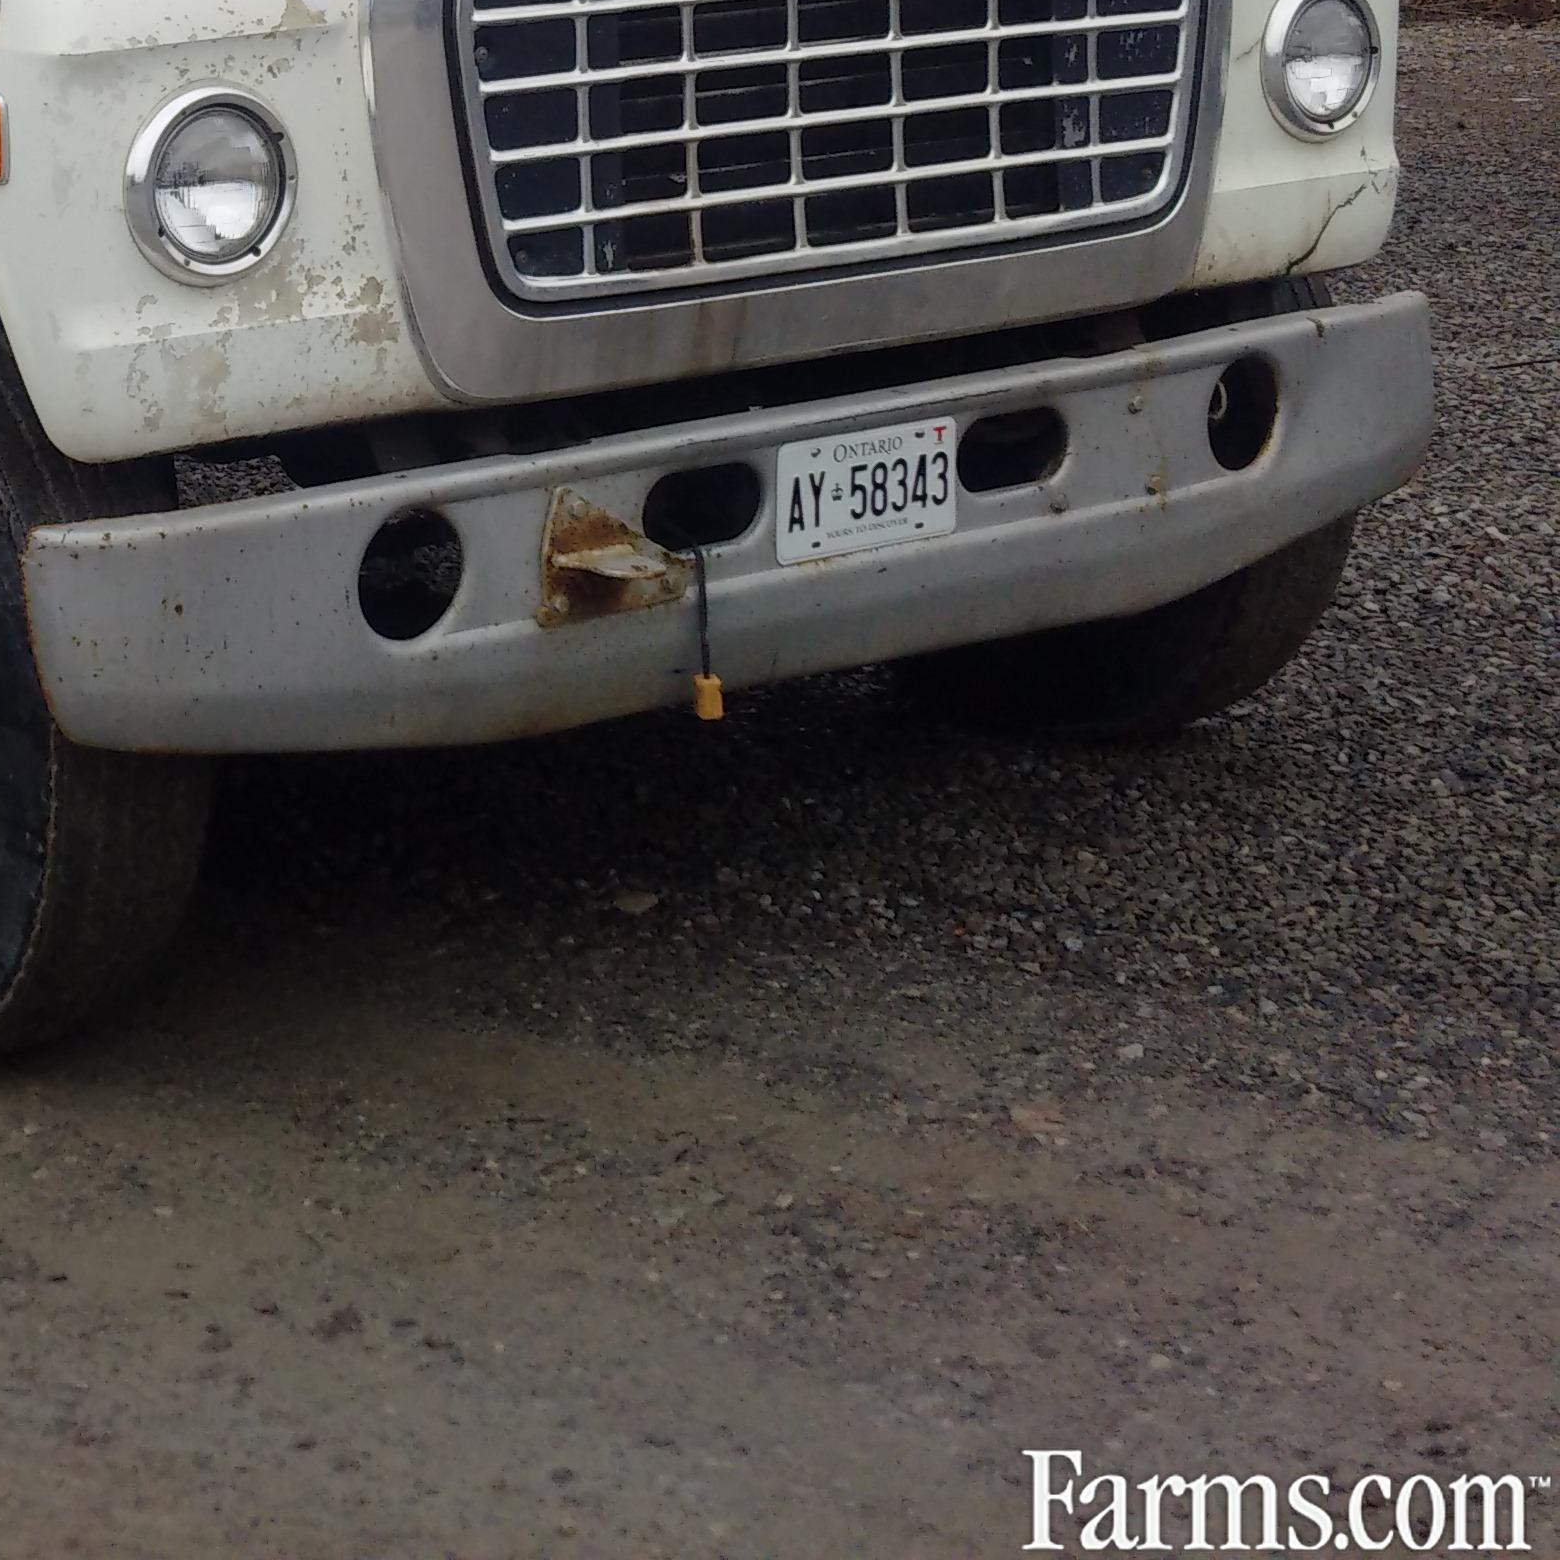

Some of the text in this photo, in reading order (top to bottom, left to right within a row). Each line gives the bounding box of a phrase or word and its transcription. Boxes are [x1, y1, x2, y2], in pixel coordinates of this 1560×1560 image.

[833, 436, 904, 463] ONTARIO
[788, 450, 950, 533] AY 58343
